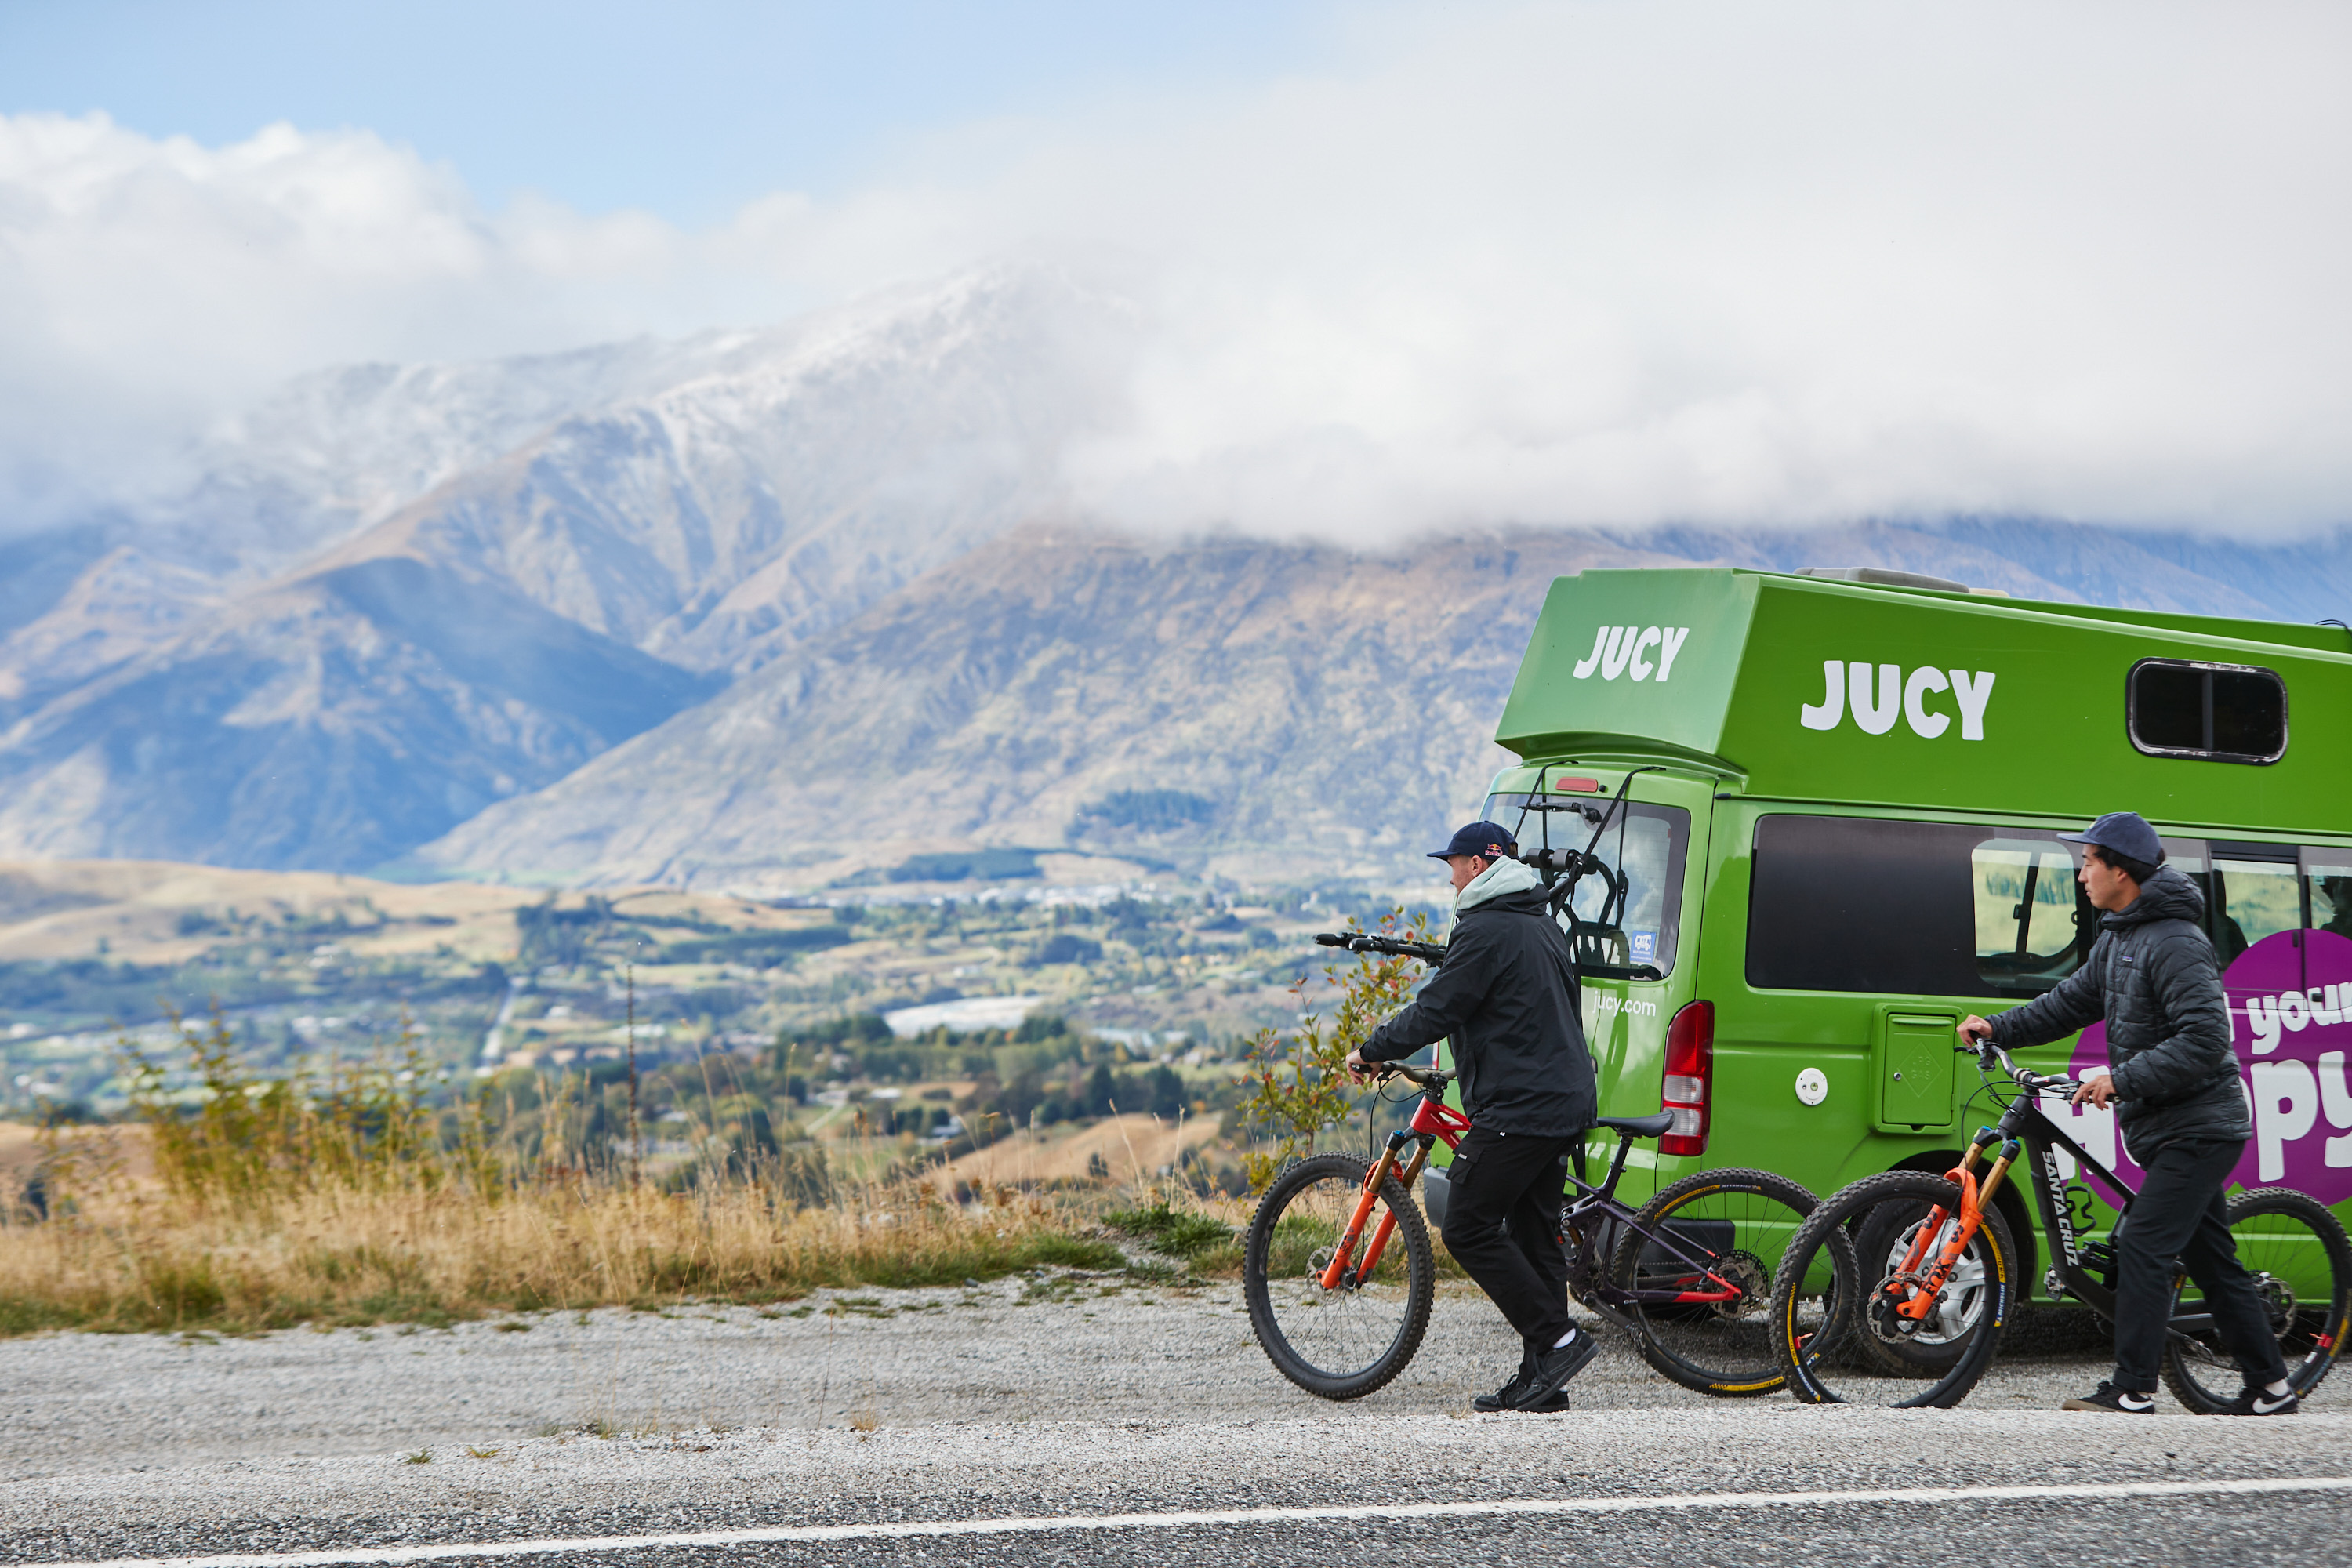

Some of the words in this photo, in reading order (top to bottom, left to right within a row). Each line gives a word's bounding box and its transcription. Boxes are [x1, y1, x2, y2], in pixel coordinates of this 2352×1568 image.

[1573, 626, 1690, 681] JUCY
[1800, 660, 1996, 741] JUCY
[1592, 990, 1657, 1017] jucy.com
[2042, 1151, 2067, 1216] SANTA
[2057, 1218, 2080, 1267] CRUZ
[1922, 1258, 1951, 1297] FOX
